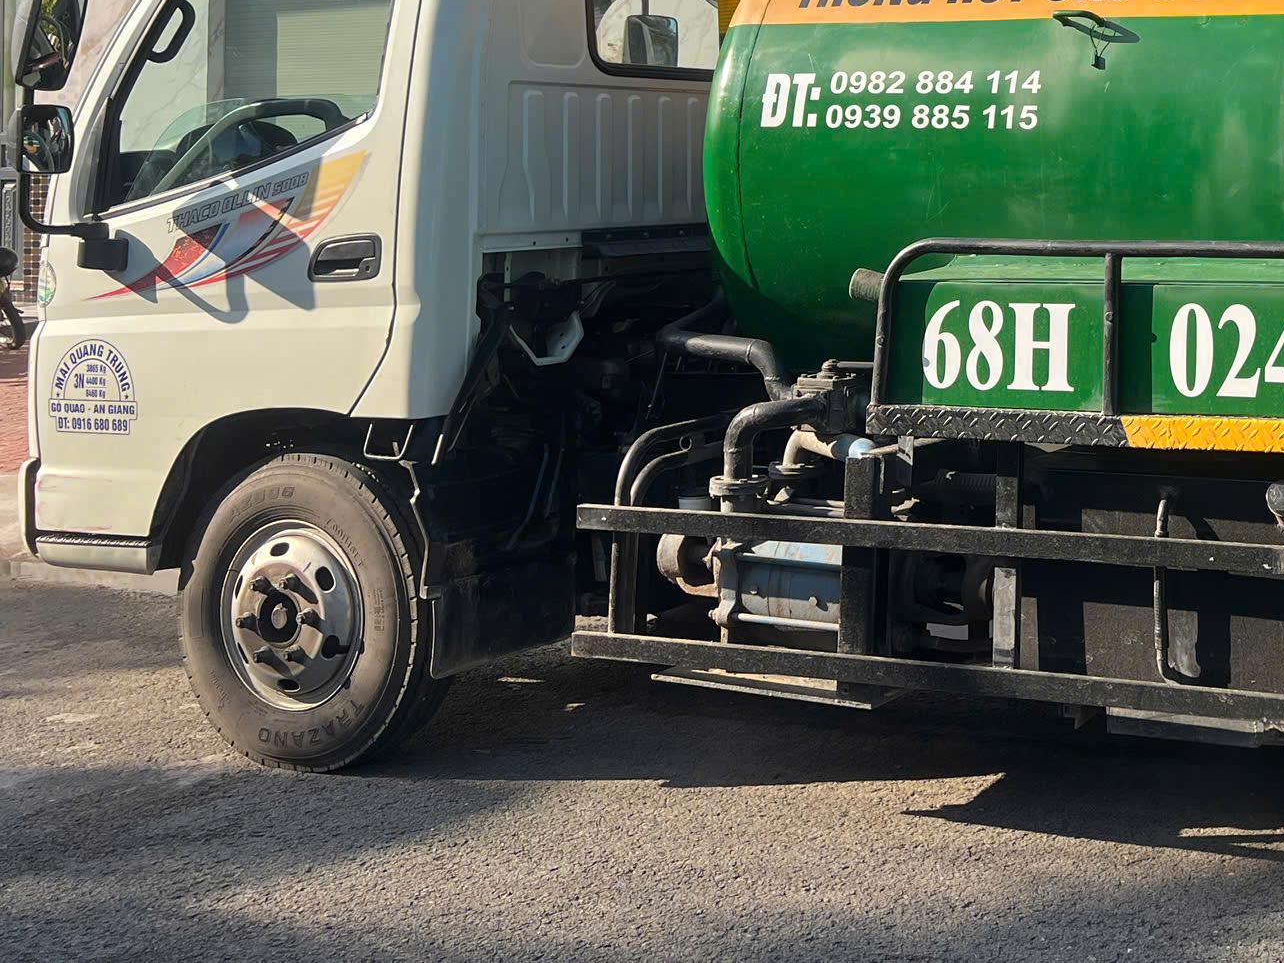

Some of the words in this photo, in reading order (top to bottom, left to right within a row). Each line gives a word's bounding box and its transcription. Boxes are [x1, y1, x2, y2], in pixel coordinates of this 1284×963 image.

[760, 72, 821, 128] ĐT:
[829, 71, 906, 95] 0982
[914, 71, 973, 94] 884
[987, 70, 1042, 94] 114
[825, 104, 901, 129] 0939
[911, 104, 970, 129] 885
[982, 104, 1038, 129] 115
[167, 200, 220, 233] THACO
[221, 182, 272, 214] OLLIN
[923, 299, 1076, 392] 68H
[55, 362, 71, 390] MAI
[69, 343, 104, 365] QUANG
[105, 349, 130, 392] TRUNG
[74, 373, 85, 389] 3N
[64, 403, 86, 414] QUAO
[93, 404, 105, 414] AN
[108, 405, 135, 415] GIANG
[72, 418, 92, 430] 0916
[94, 419, 109, 431] 680
[112, 419, 128, 432] 689
[257, 699, 366, 751] TRAZANO
